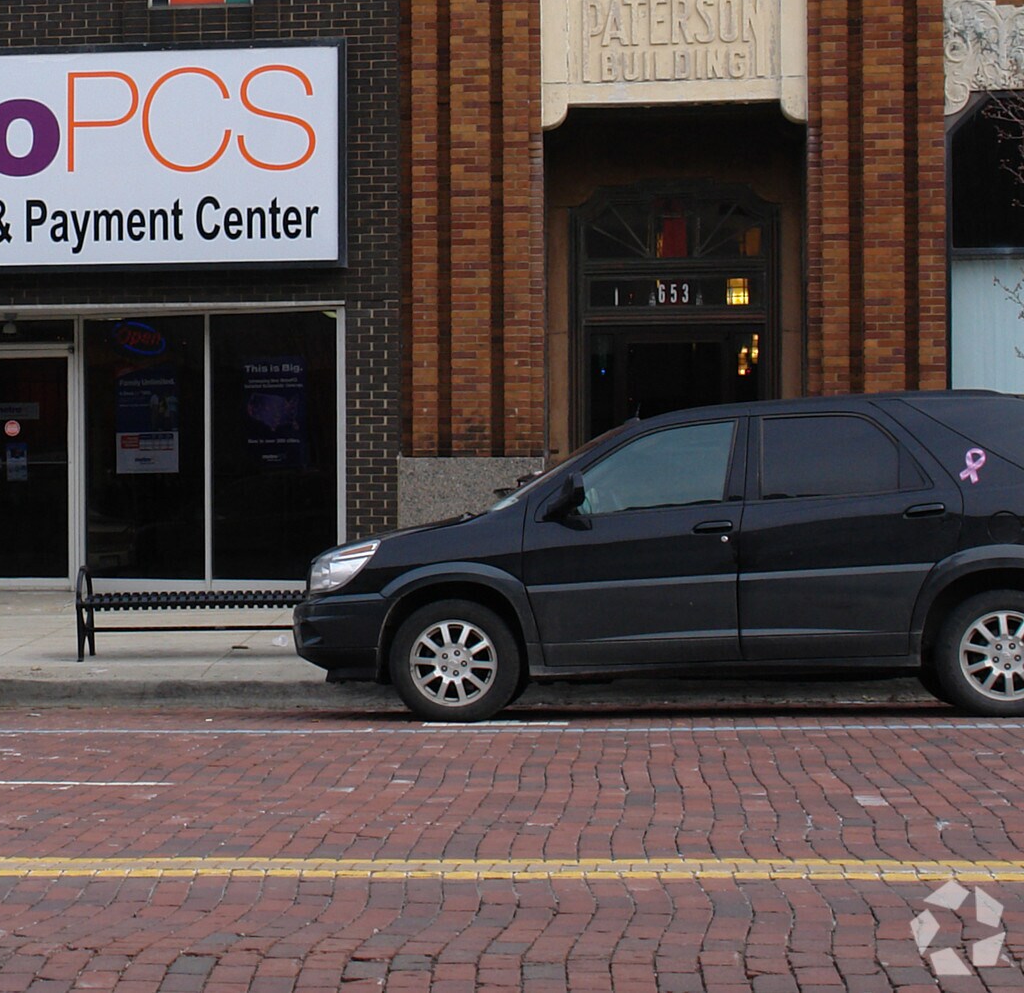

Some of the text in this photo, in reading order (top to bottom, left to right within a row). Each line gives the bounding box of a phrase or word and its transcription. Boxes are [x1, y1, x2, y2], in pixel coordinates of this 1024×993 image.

[600, 47, 746, 83] BUILDING
[26, 198, 183, 254] Payment
[196, 196, 319, 240] Center
[658, 283, 689, 303] 653
[244, 364, 268, 373] This
[270, 364, 280, 373] is
